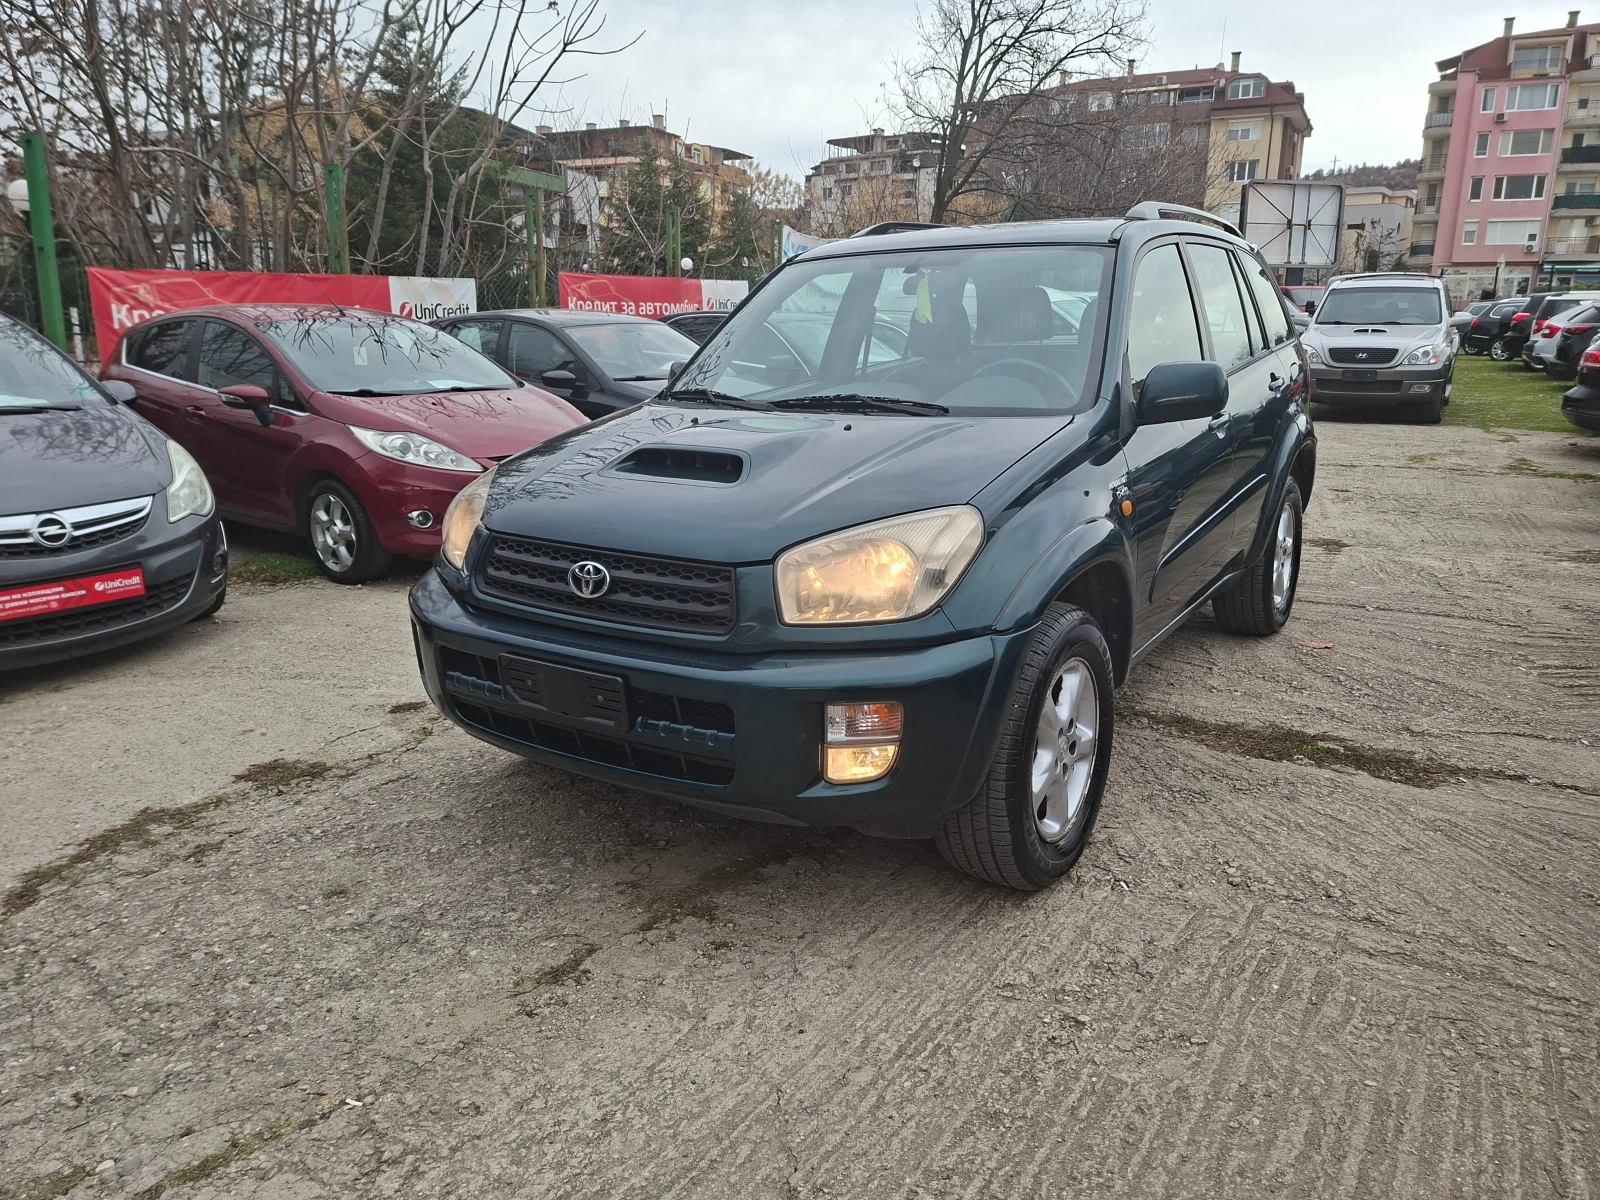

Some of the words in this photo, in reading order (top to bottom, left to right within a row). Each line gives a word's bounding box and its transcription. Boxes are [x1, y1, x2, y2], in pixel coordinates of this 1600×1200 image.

[414, 302, 470, 320] UniCredit
[568, 296, 617, 312] Кредит
[621, 301, 636, 315] за
[104, 576, 140, 589] UniCredit
